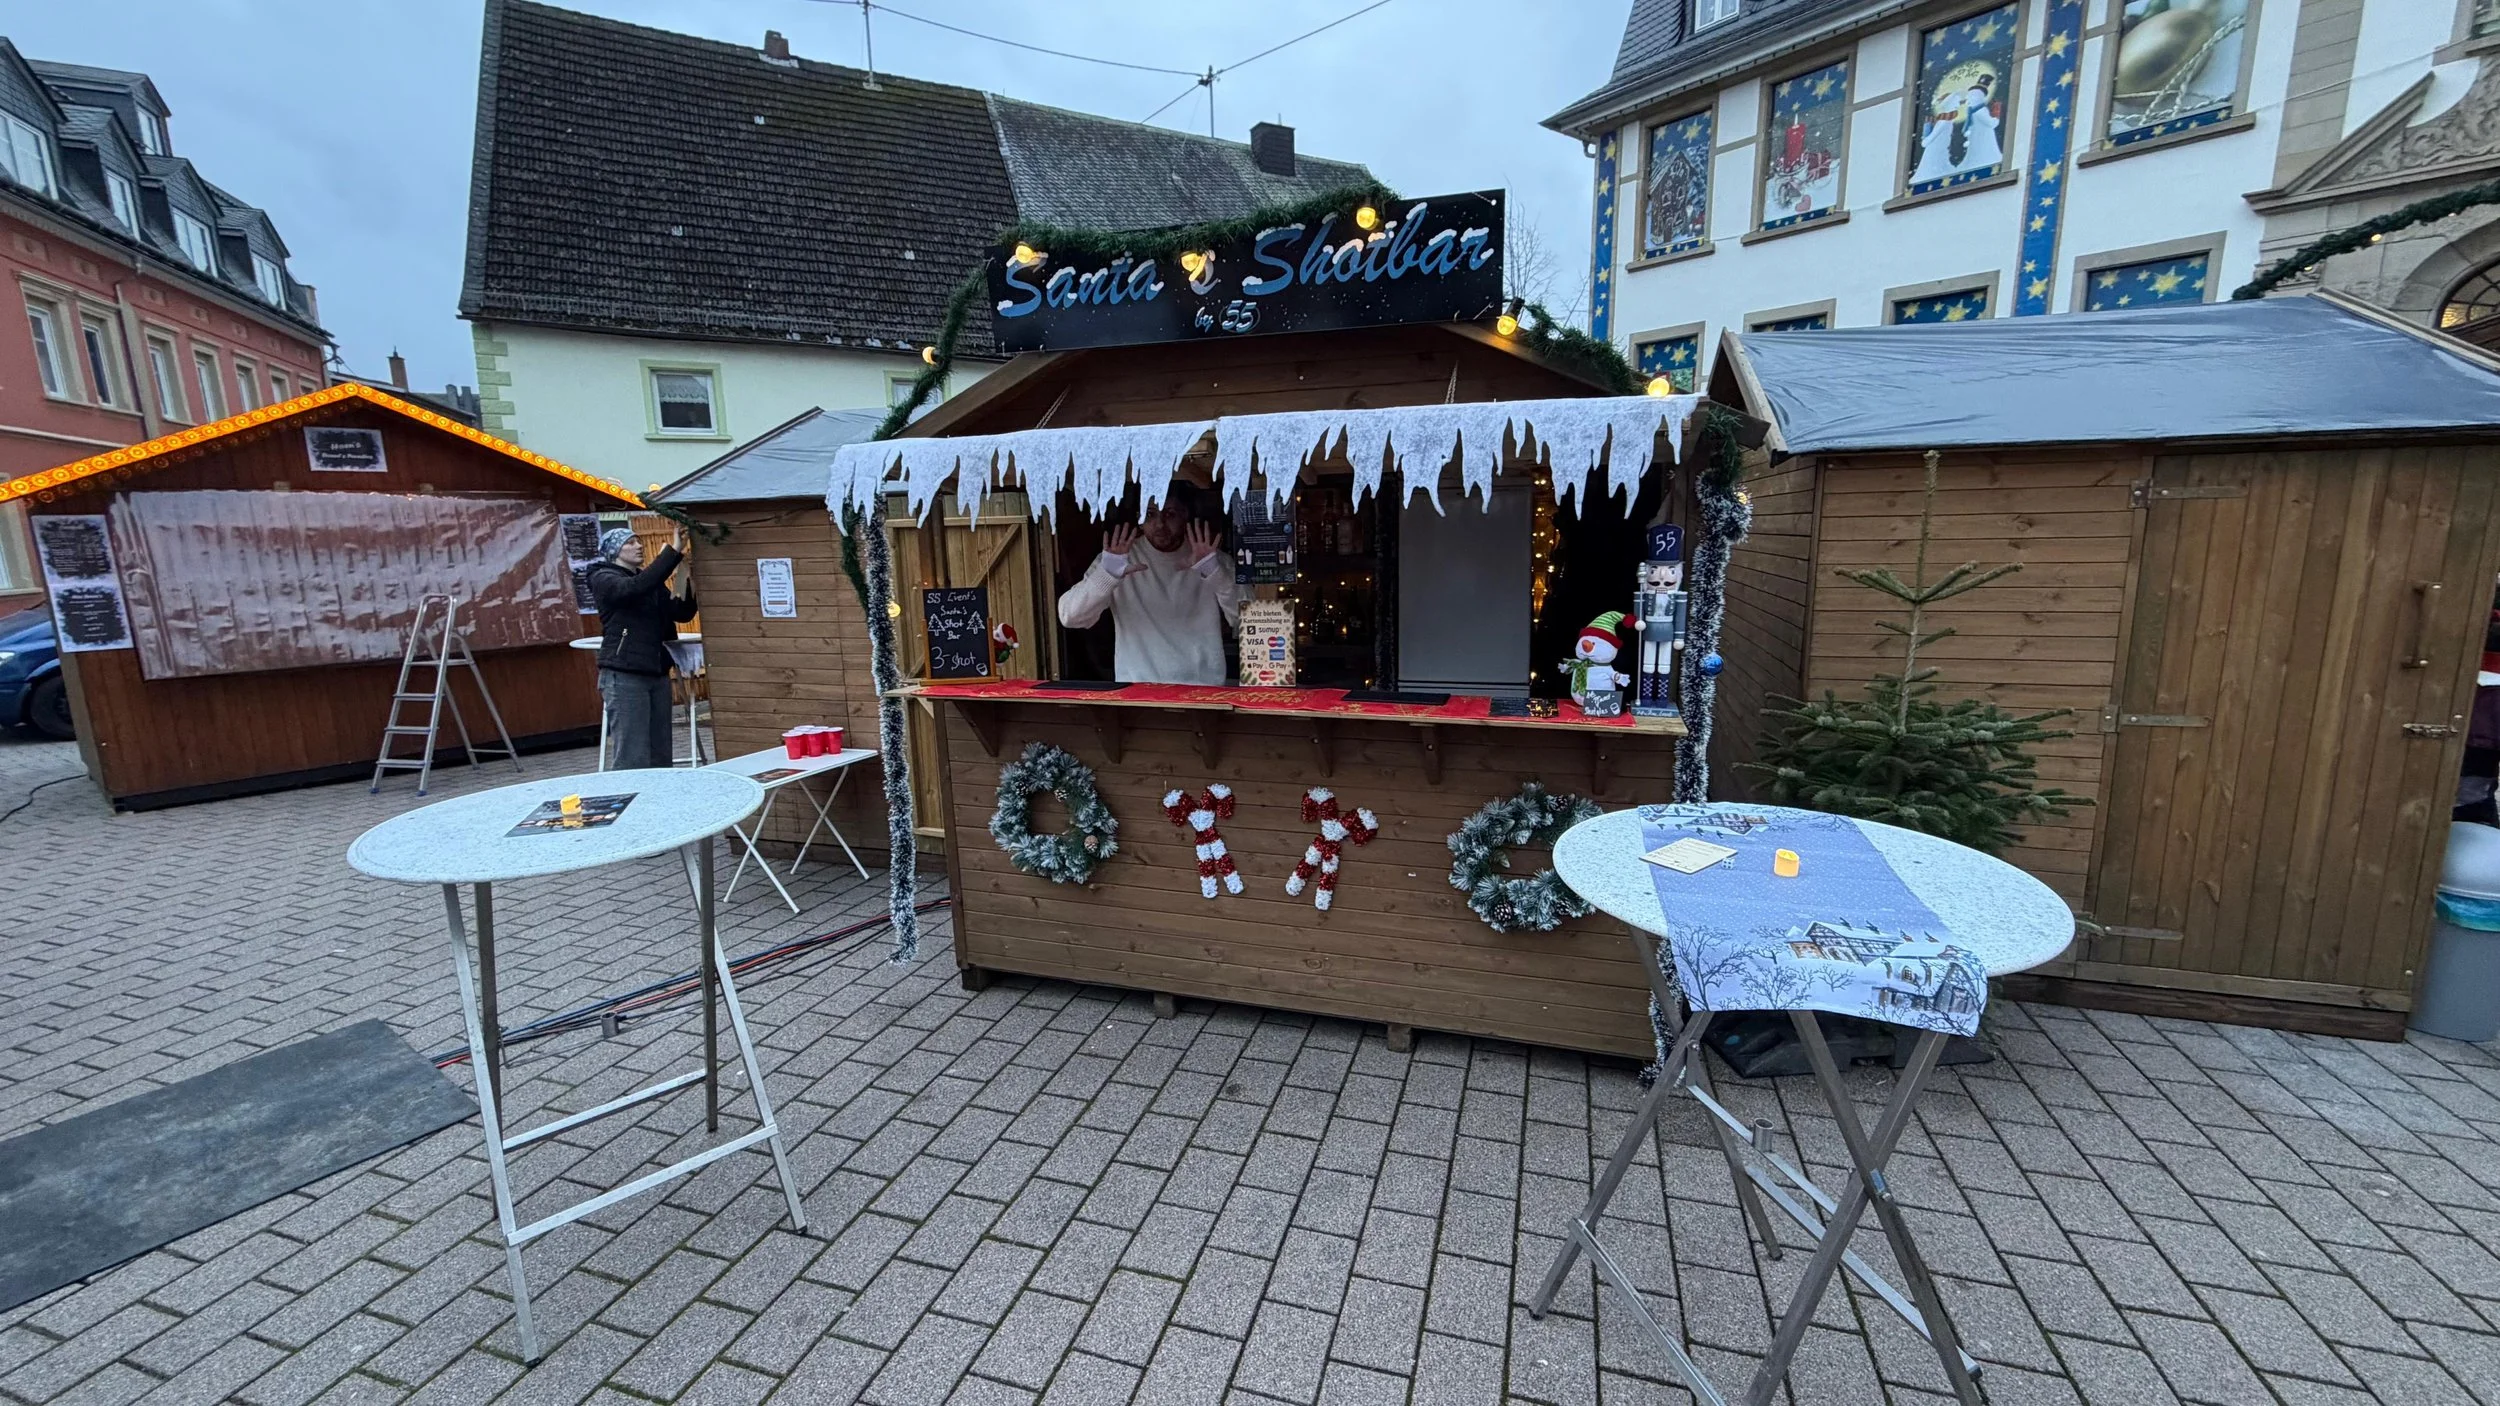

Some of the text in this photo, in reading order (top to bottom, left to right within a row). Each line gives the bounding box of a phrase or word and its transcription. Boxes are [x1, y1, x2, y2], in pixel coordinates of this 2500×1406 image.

[997, 250, 1164, 317] Santa
[1242, 202, 1494, 296] Shotbar
[1194, 300, 1257, 333] by 55
[1656, 531, 1676, 556] 55
[944, 618, 965, 629] Shot
[947, 630, 961, 640] Bar
[1246, 638, 1265, 646] VISA
